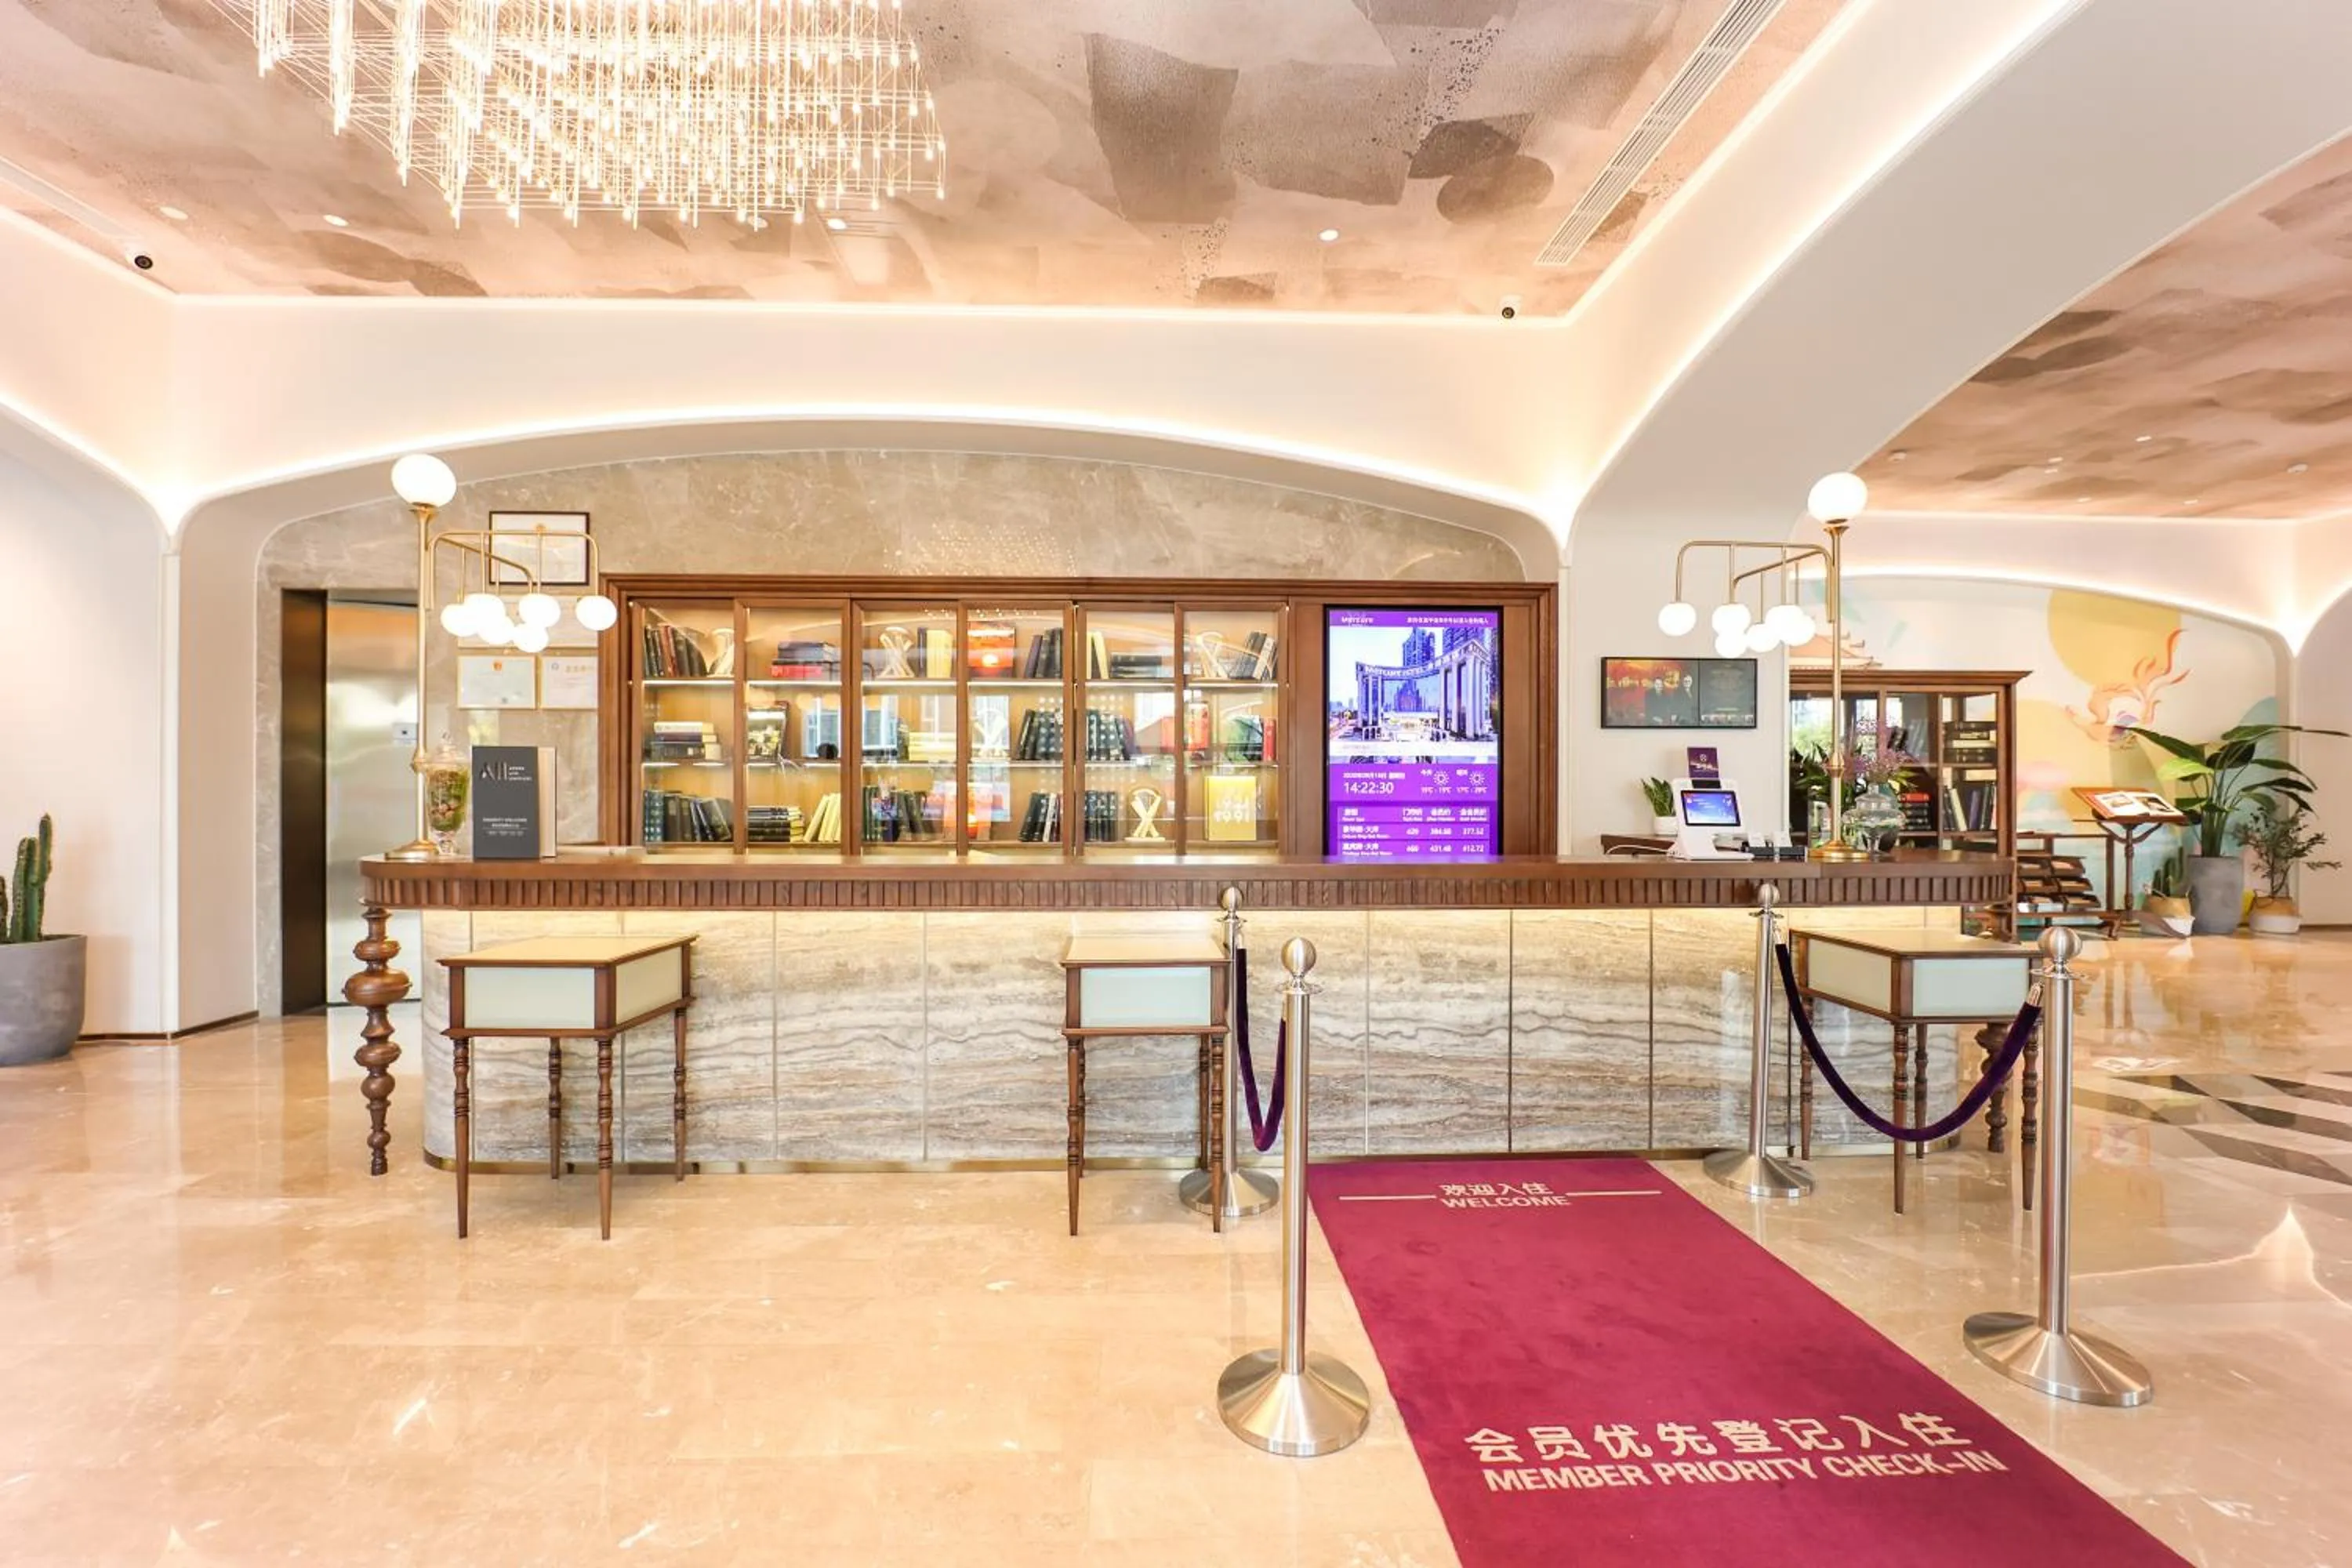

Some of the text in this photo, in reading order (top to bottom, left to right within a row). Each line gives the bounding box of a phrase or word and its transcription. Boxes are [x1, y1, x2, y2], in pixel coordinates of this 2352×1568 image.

[1344, 782, 1394, 794] 14:22:30
[1439, 1181, 1554, 1196] 欢迎入住
[1439, 1196, 1571, 1208] WELCOME
[1464, 1411, 1973, 1465] 会员优先登记入住
[1483, 1449, 2010, 1493] MEMBER PRIORITY CHECK-IN
